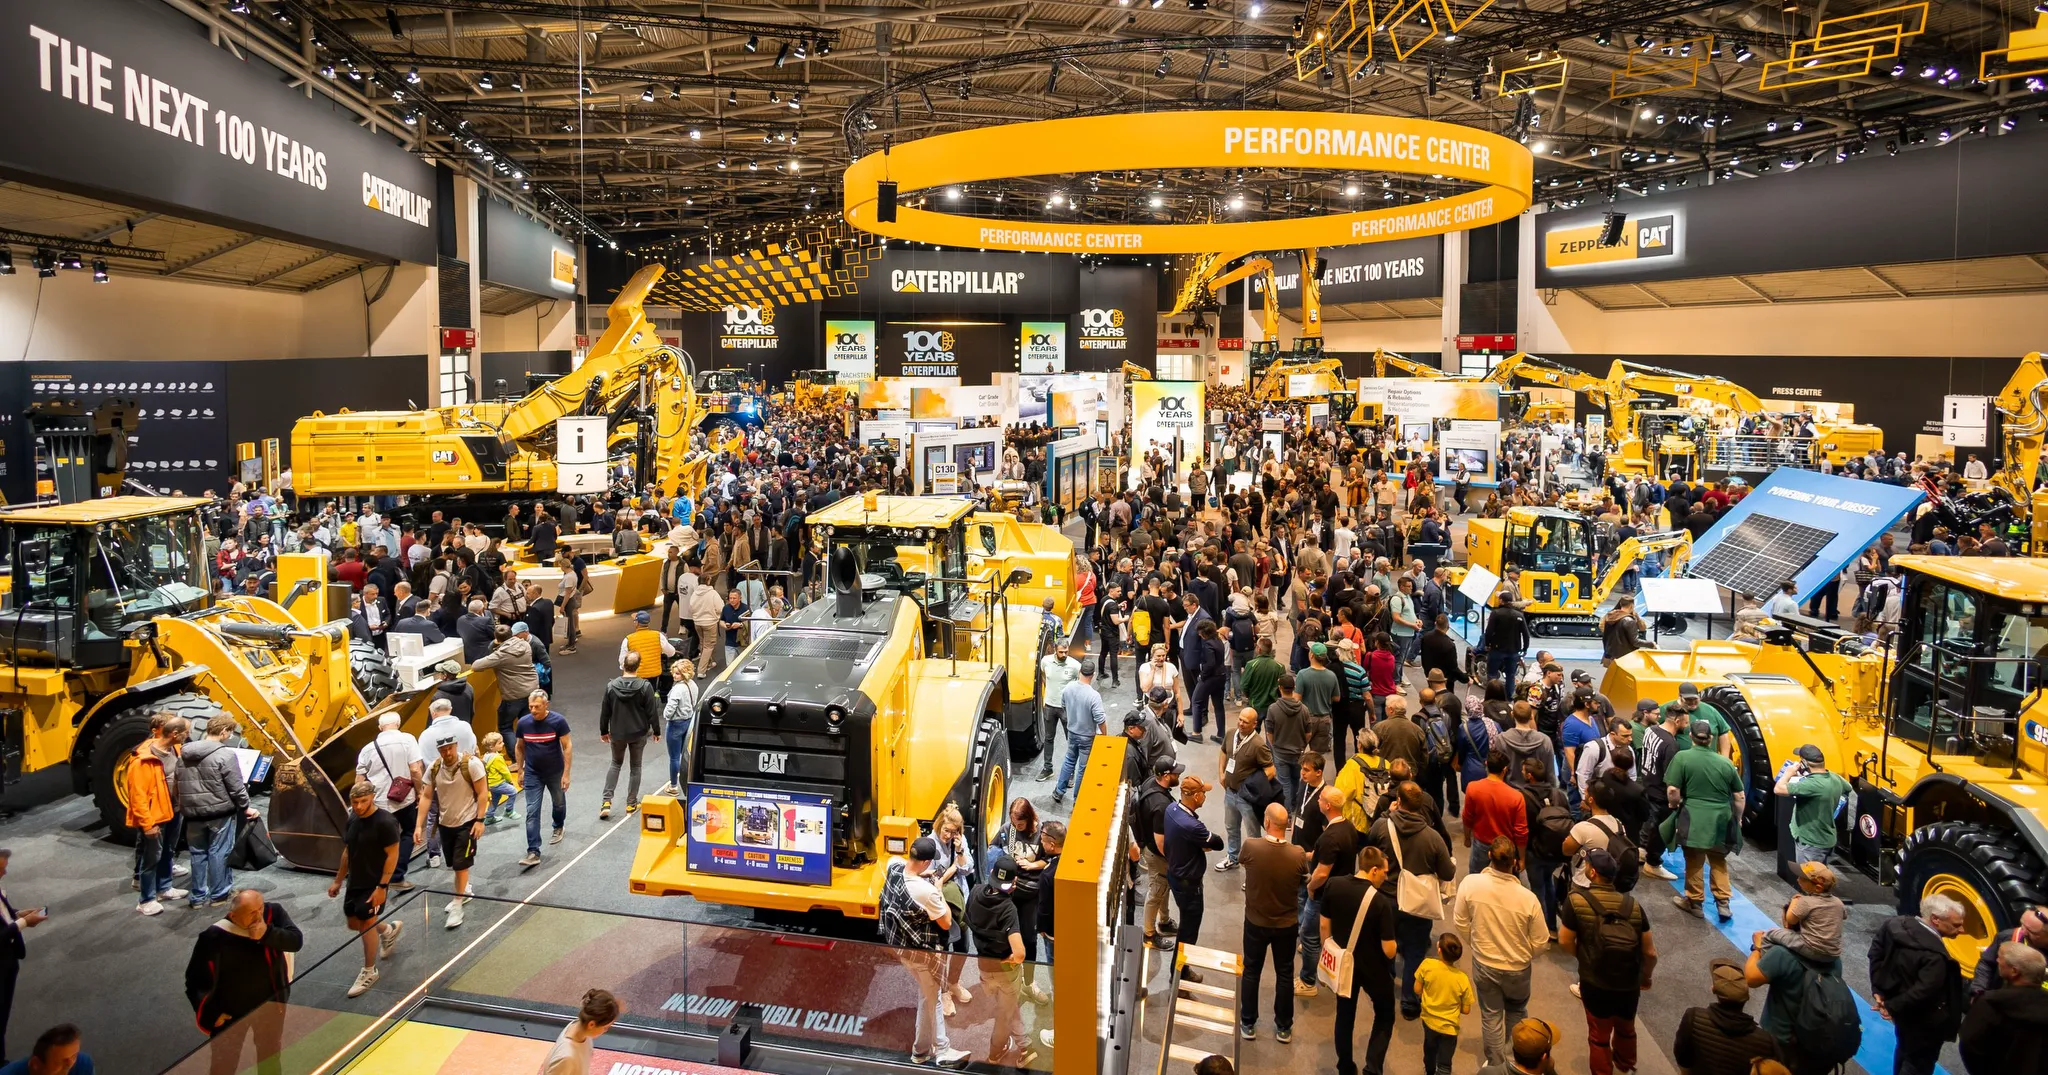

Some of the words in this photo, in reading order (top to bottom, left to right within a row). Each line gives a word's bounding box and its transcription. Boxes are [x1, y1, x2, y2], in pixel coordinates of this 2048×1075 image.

[30, 25, 113, 114] THE
[124, 66, 208, 147] NEXT
[215, 109, 256, 165] 100
[261, 126, 328, 191] YEARS
[1224, 127, 1420, 160] PERFORMANCE
[1426, 137, 1490, 171] CENTER
[1352, 208, 1451, 237] PERFORMANCE
[1454, 197, 1493, 224] CENTER
[980, 228, 1082, 247] PERFORMANCE
[1086, 233, 1142, 248] CENTER
[1639, 225, 1671, 248] CAT
[1335, 265, 1362, 284] NEXT
[1364, 263, 1381, 281] 100
[1385, 257, 1424, 278] YEARS
[1080, 308, 1125, 328] 100
[723, 324, 775, 335] YEARS
[1081, 327, 1125, 337] YEARS
[903, 330, 955, 352] 100
[904, 351, 955, 362] YEARS
[1545, 372, 1558, 382] CAT
[1674, 383, 1691, 393] CAT
[1772, 387, 1794, 396] PRESS
[1795, 388, 1823, 396] CENTRE
[1158, 410, 1193, 418] YEARS
[1950, 432, 1956, 441] 3
[1823, 442, 1835, 450] CAT
[432, 450, 454, 463] CAT
[935, 465, 956, 474] C13D
[576, 473, 584, 486] 2
[101, 486, 113, 497] CAT
[1767, 486, 1815, 503] POWERING
[1812, 495, 1840, 508] YOUR
[1836, 500, 1880, 516] JOBSITE
[758, 752, 788, 774] CAT
[748, 852, 766, 860] CAUTION
[778, 856, 802, 864] AWARENESS
